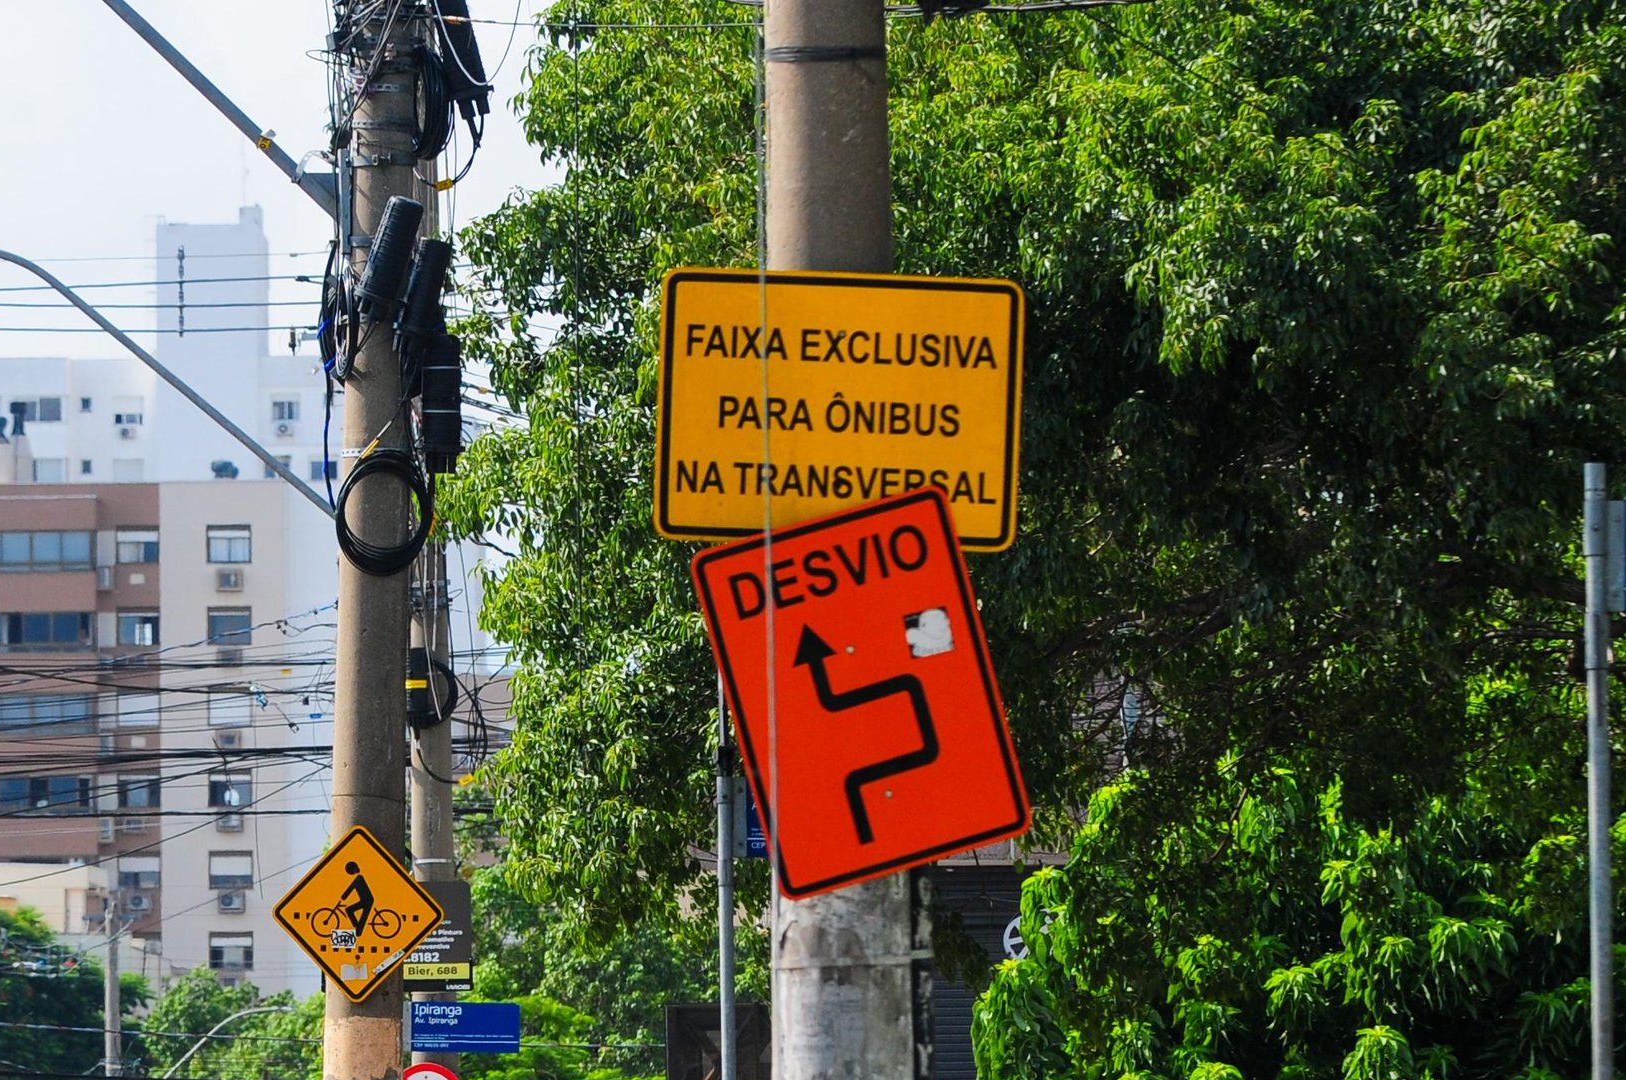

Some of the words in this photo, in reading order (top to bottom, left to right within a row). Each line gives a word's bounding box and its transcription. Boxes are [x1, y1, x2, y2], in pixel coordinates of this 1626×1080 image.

[686, 324, 788, 361] FAIXA
[800, 329, 997, 369] EXCLUSIVA
[719, 395, 813, 432] PARA
[826, 392, 960, 436] ÔNIBUS
[676, 460, 725, 494] NA
[734, 461, 997, 505] TRANSVERSAL
[728, 524, 928, 621] DESVIO
[408, 965, 434, 977] Bier,
[436, 966, 458, 975] 688
[414, 1003, 462, 1018] Ipiranga
[428, 1017, 458, 1026] Ipiranga
